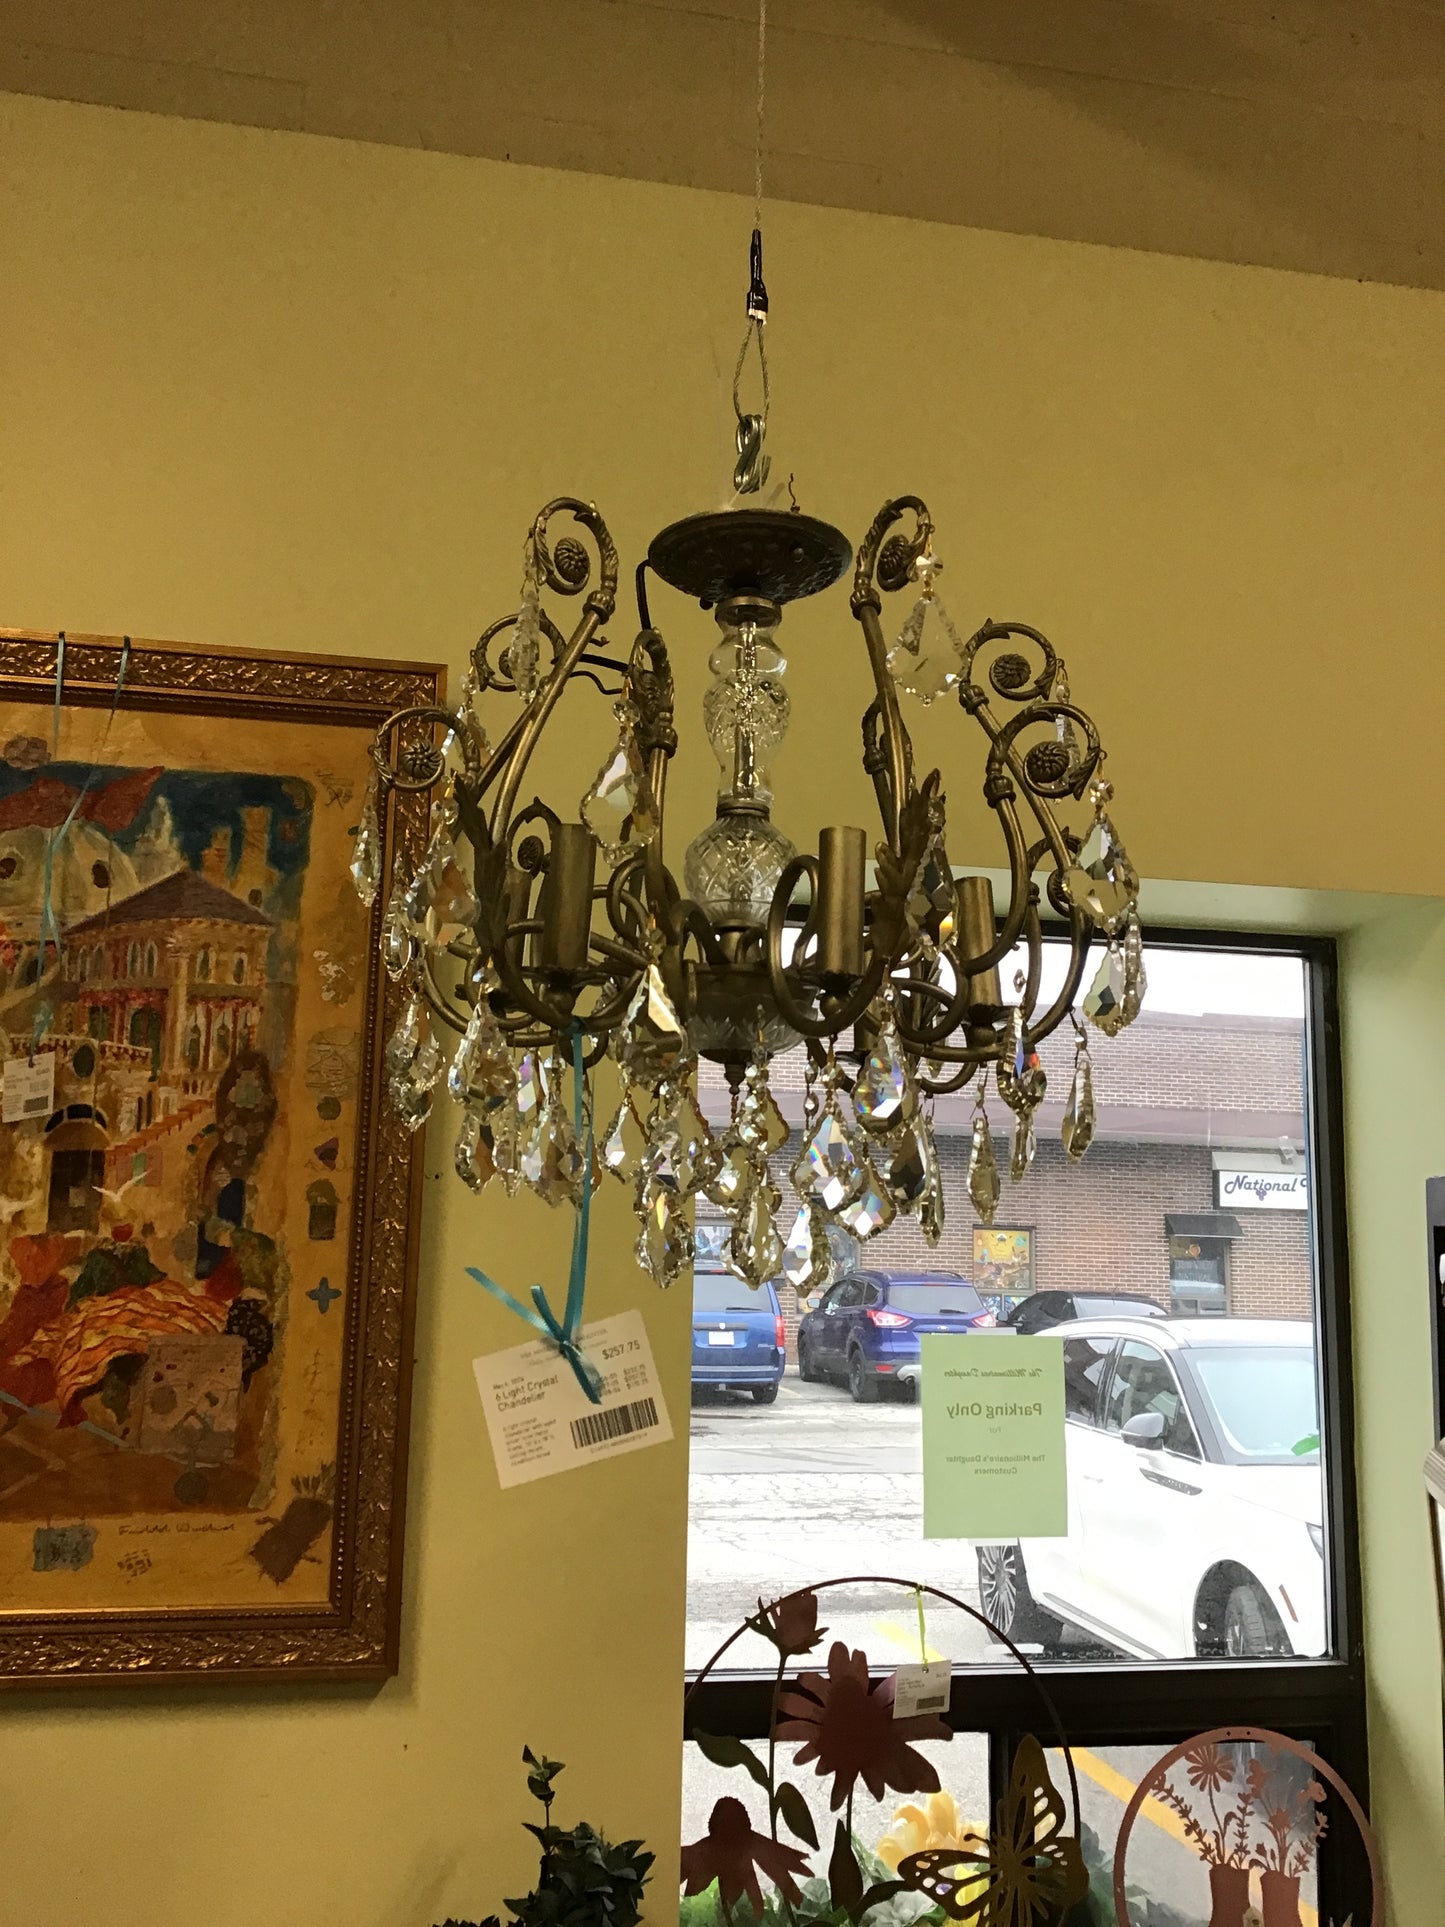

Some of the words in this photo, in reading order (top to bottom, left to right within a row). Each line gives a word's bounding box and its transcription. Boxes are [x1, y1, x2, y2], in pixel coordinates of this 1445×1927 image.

[1224, 1175, 1298, 1194] National
[602, 1340, 640, 1360] $257.75
[495, 1393, 502, 1402] 6
[502, 1385, 526, 1400] Light
[527, 1374, 559, 1392] Crystal
[498, 1391, 546, 1412] Chandelier
